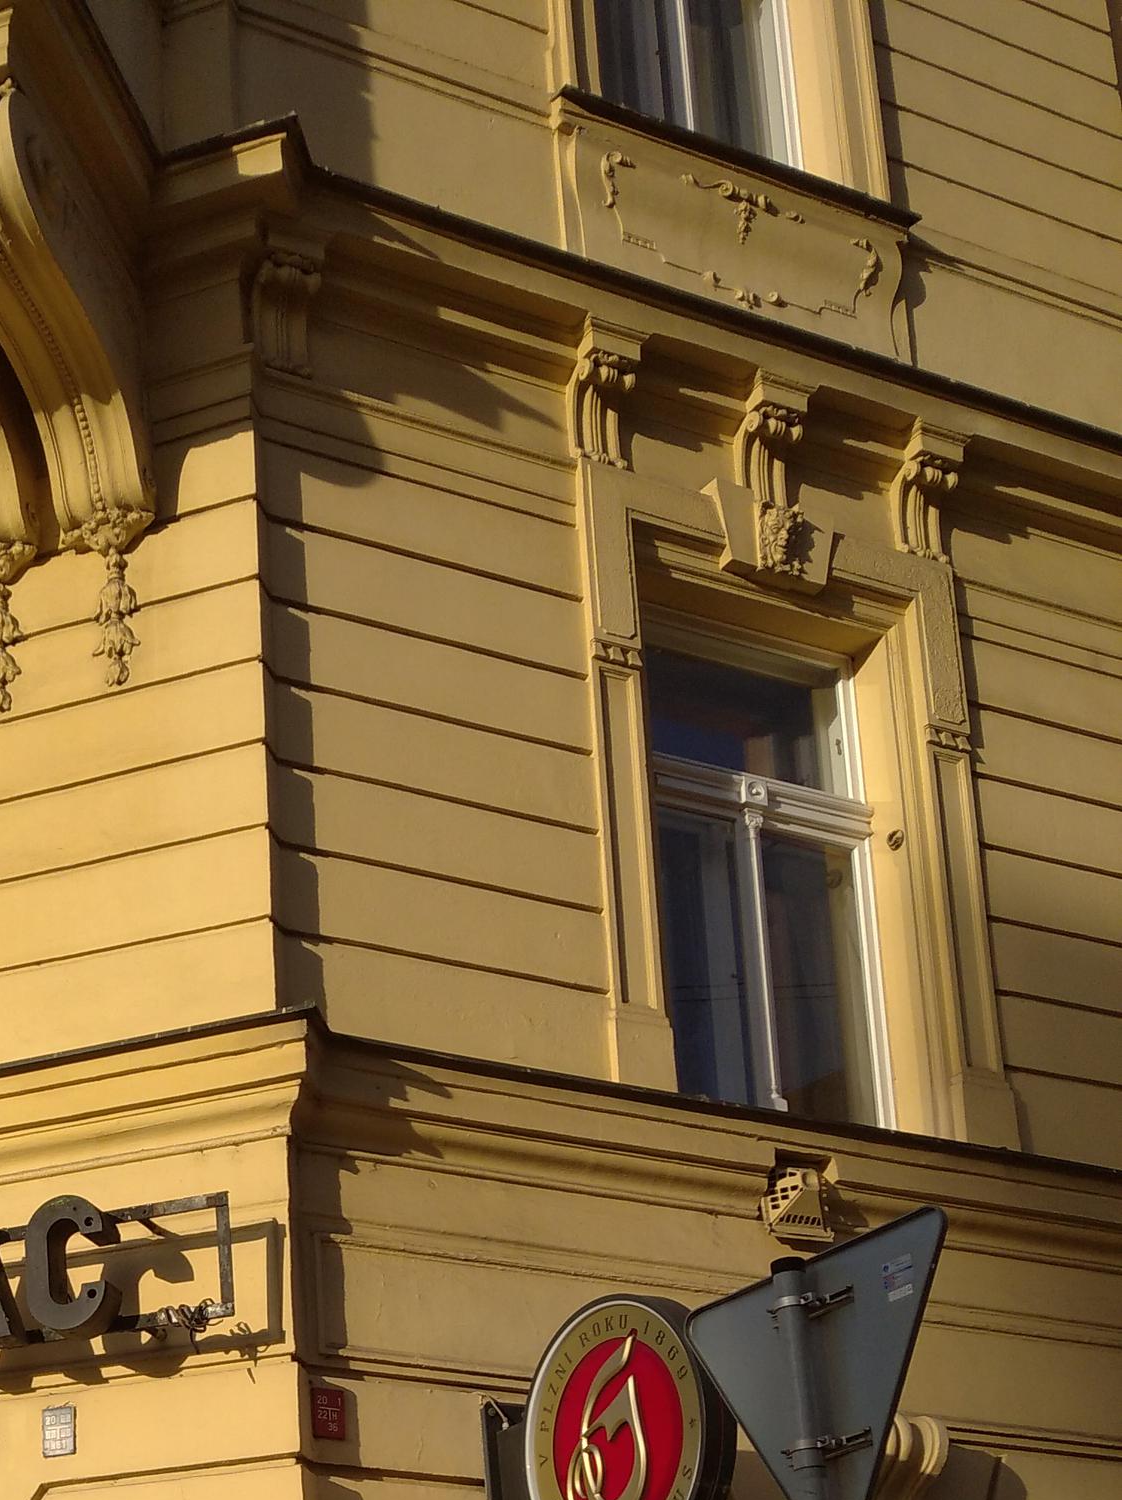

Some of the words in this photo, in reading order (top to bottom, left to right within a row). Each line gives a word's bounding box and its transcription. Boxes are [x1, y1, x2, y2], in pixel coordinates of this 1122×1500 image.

[539, 1351, 573, 1433] PLZNI
[577, 1313, 629, 1349] ROKU
[643, 1320, 689, 1380] 1869
